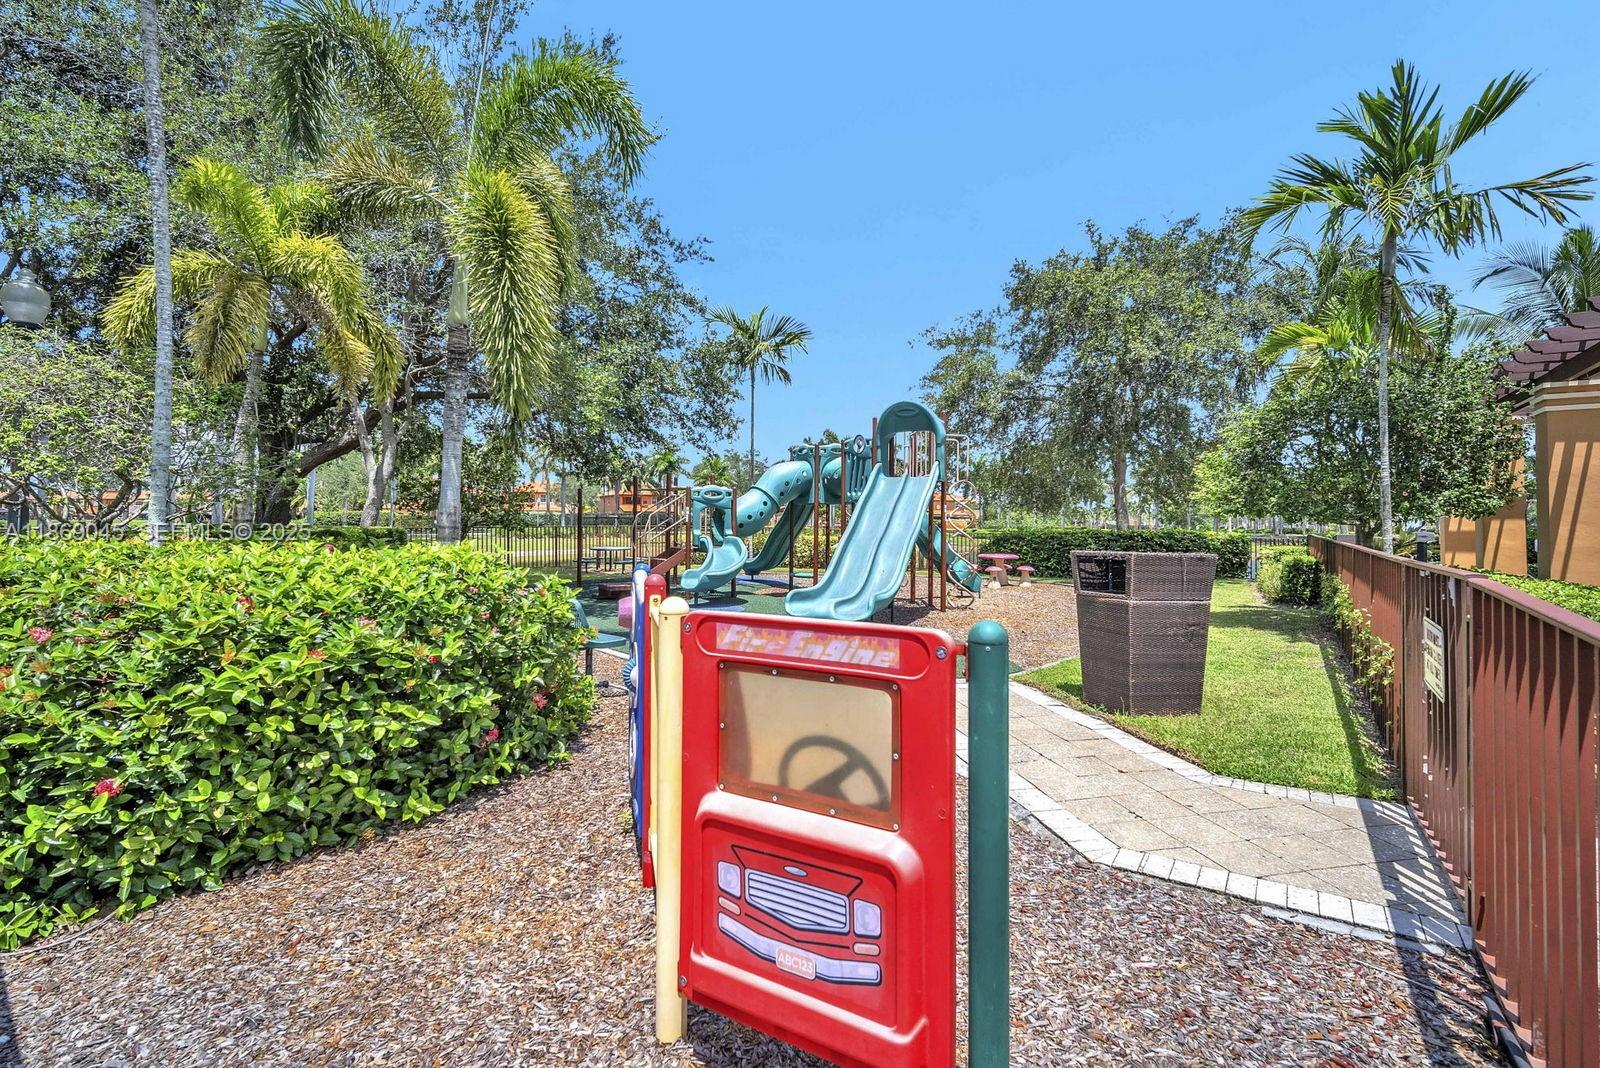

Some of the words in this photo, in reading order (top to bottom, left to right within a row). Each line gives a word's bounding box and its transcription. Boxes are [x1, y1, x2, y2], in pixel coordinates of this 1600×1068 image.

[724, 623, 785, 653] Fire
[787, 630, 896, 668] Engine
[778, 952, 813, 973] ABC123
